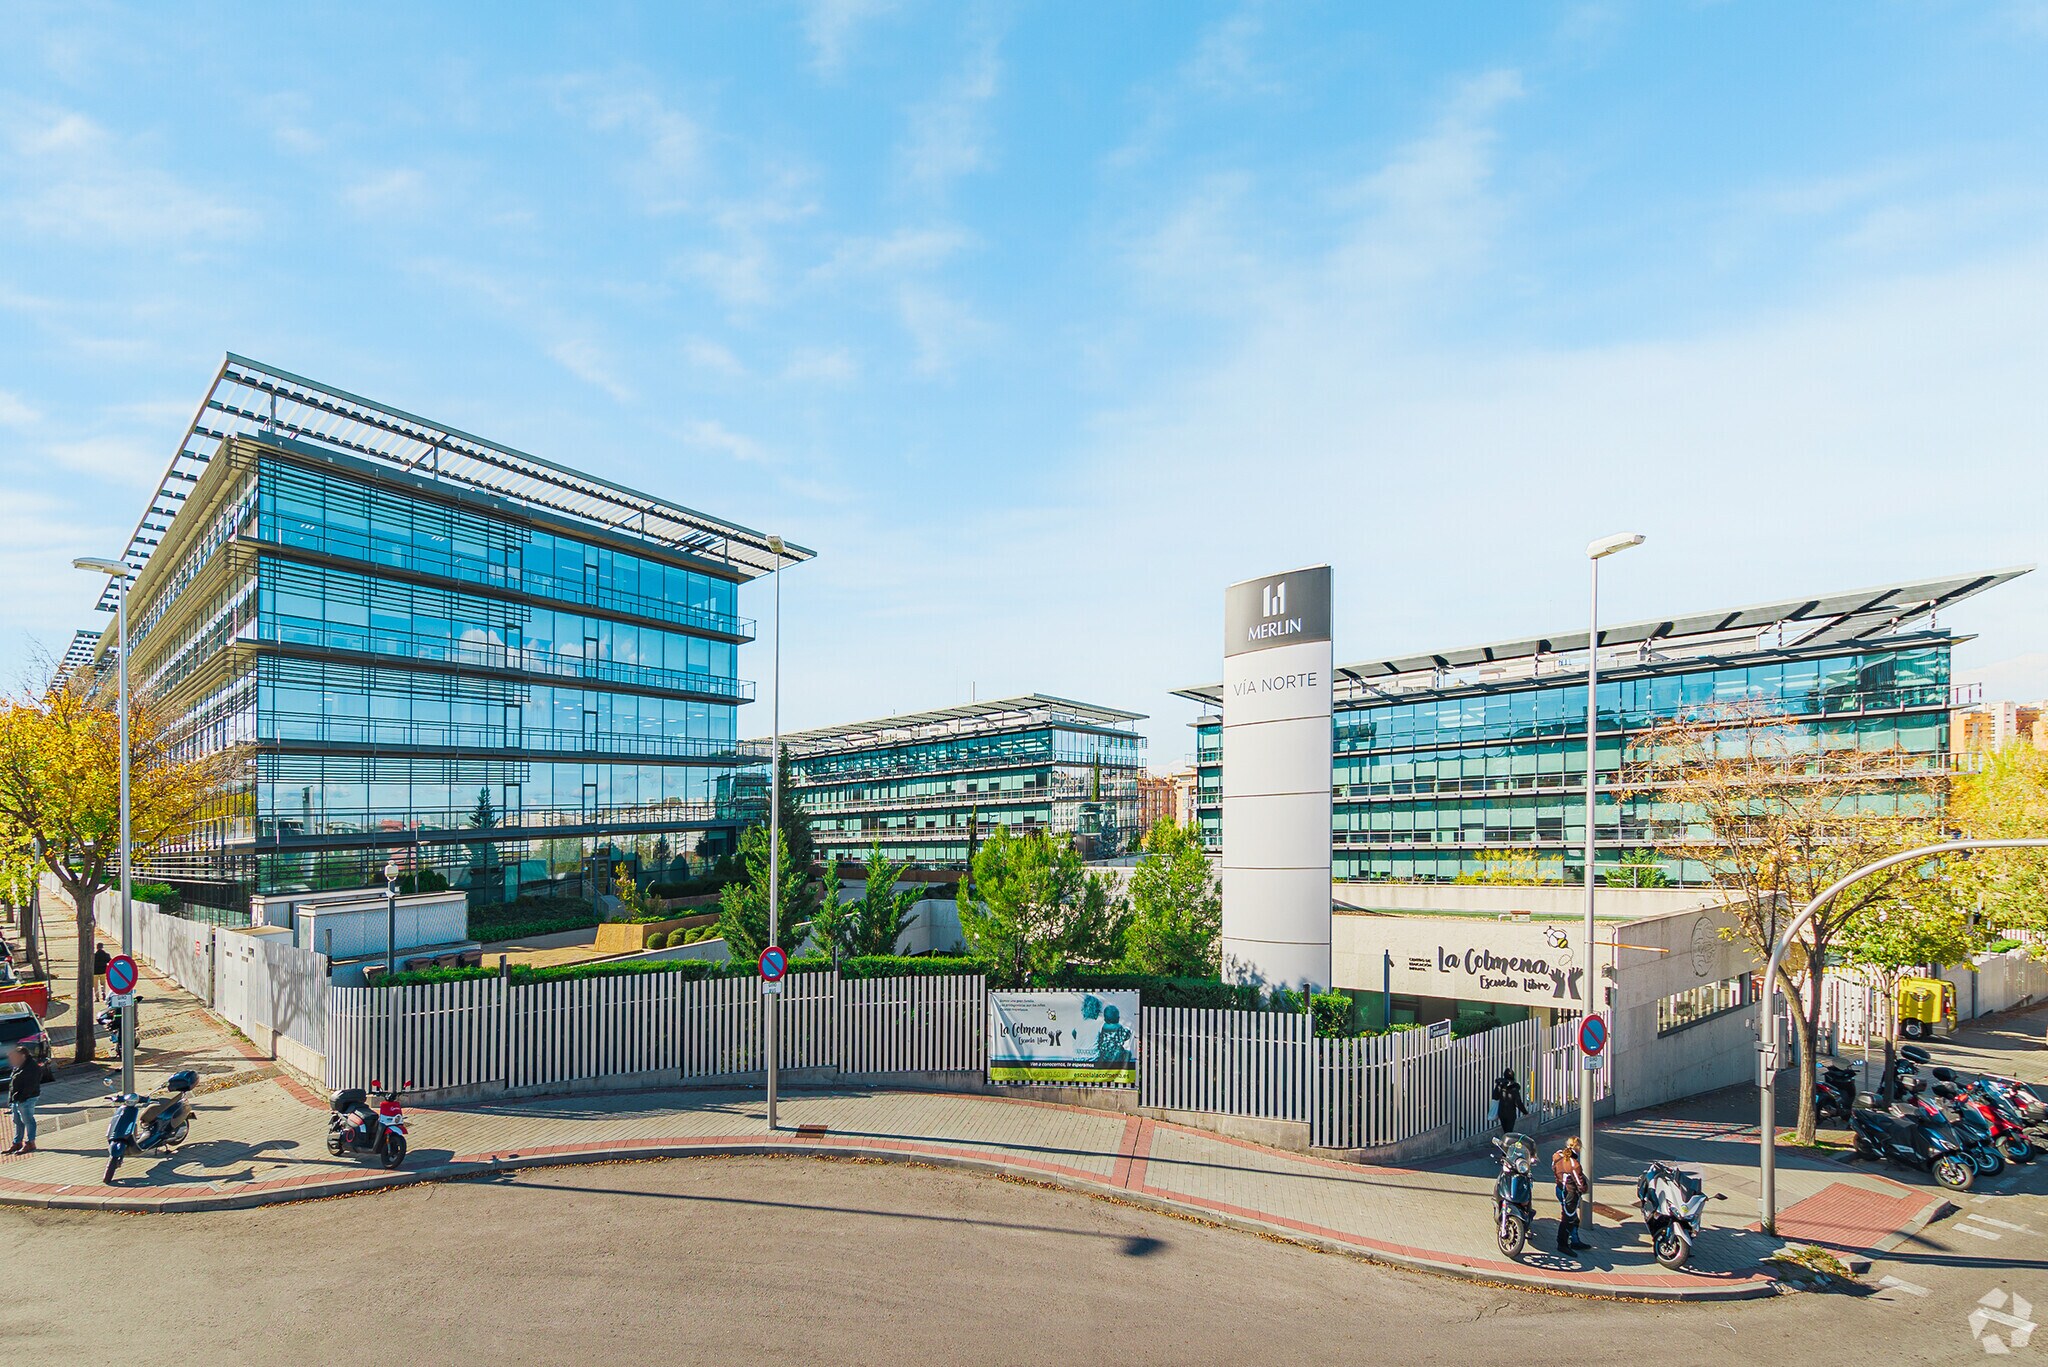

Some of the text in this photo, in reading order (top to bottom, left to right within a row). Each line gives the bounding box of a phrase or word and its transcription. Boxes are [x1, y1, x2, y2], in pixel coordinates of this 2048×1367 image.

[1248, 617, 1301, 641] MERLIN
[1233, 672, 1317, 696] VÍA NORTE
[1438, 946, 1551, 976] La Colmena
[1479, 974, 1551, 992] Escuela Libre
[1000, 1022, 1047, 1038] La Colmena
